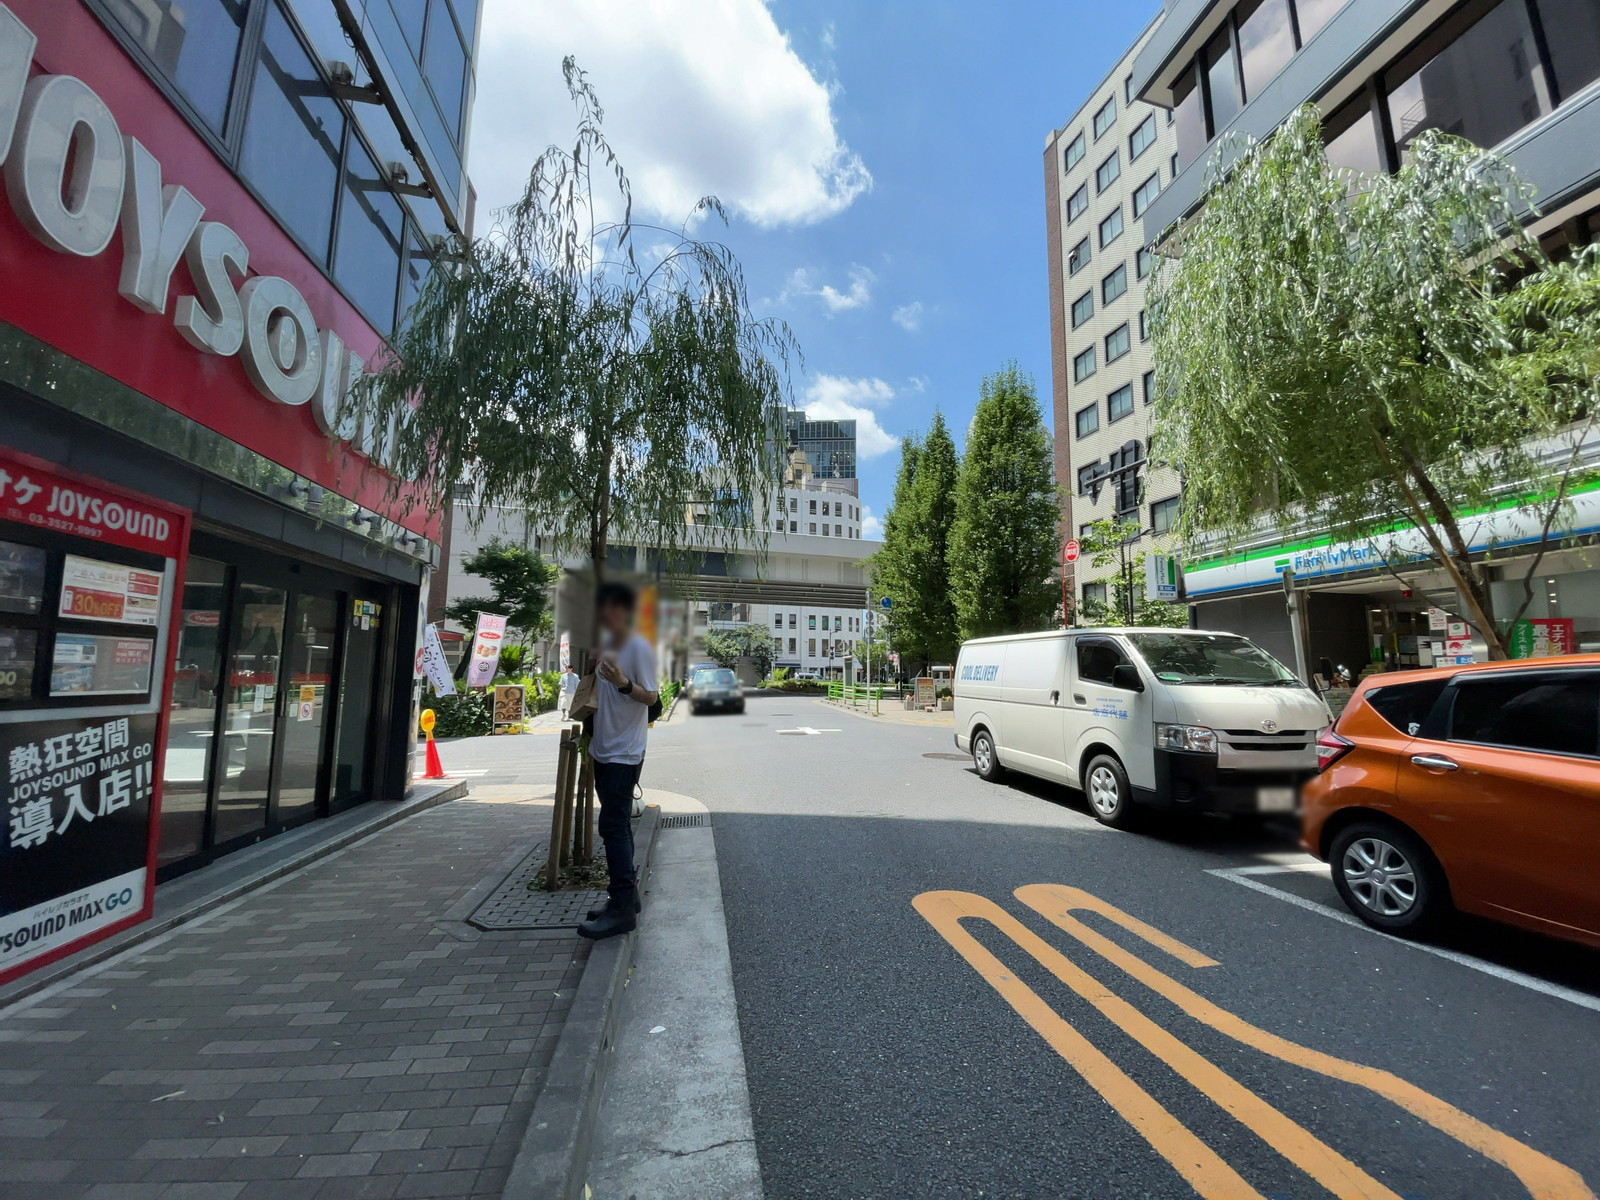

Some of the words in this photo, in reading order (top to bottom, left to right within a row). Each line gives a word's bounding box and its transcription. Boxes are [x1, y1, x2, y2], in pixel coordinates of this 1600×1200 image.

[47, 486, 170, 542] JOYSOUND
[1294, 545, 1377, 570] FamilyMart
[961, 665, 974, 680] COOL
[972, 665, 999, 682] DELIVERY
[8, 717, 130, 784] 熱狂空間
[8, 761, 96, 804] JOYSOUND
[100, 749, 130, 772] MAX
[133, 743, 152, 760] GO
[68, 897, 104, 927] MAX
[105, 887, 133, 911] GO
